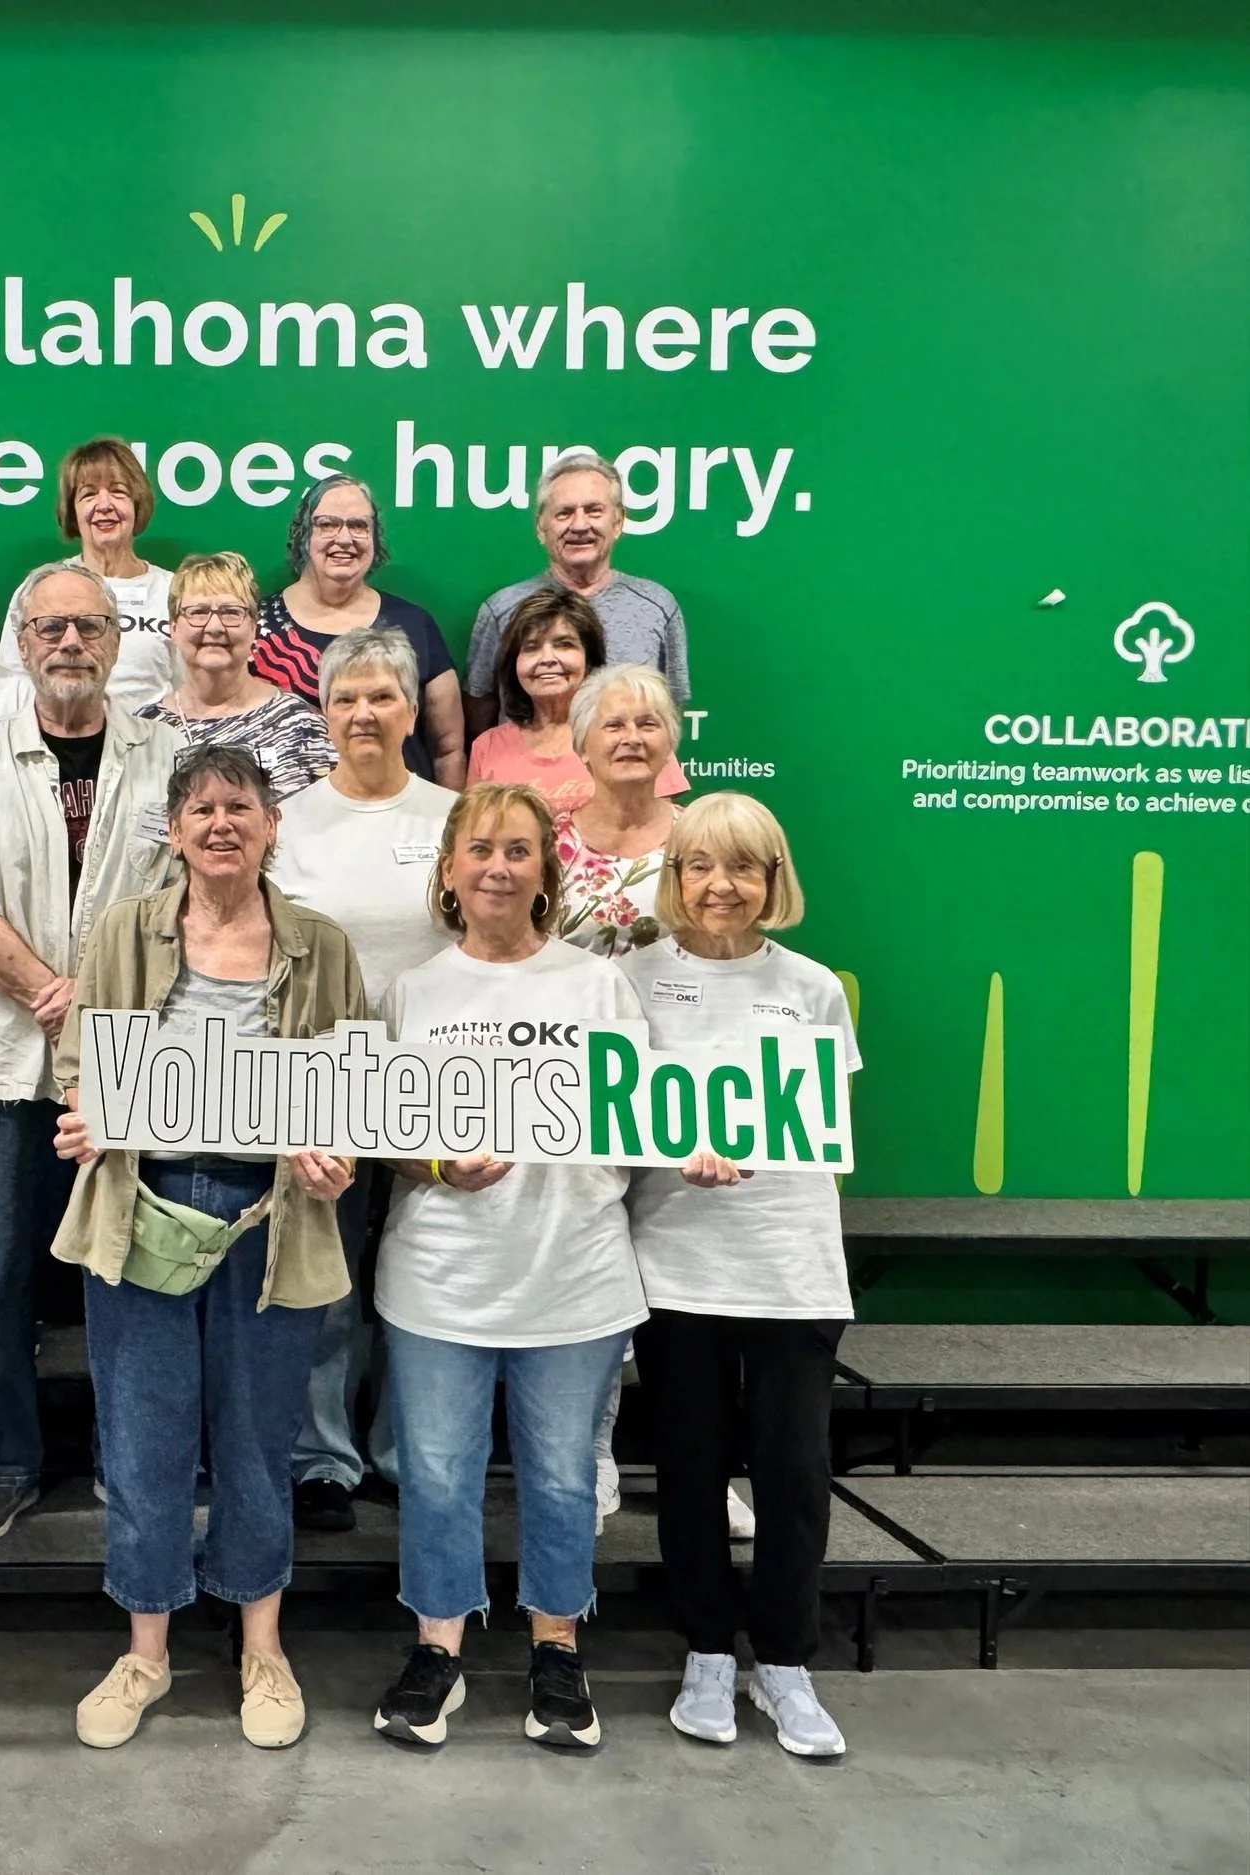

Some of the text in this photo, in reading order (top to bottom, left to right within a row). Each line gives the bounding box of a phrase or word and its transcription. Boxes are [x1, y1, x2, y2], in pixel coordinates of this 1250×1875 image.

[461, 282, 816, 373] where
[131, 441, 353, 507] oes
[395, 420, 811, 537] hugry.
[118, 614, 172, 639] OKC
[681, 757, 776, 778] rtunities
[902, 759, 1026, 786] Prioritizing
[1032, 761, 1150, 783] teamwork
[1155, 767, 1182, 784] as
[1188, 767, 1222, 785] we
[913, 789, 957, 809] and
[963, 790, 1109, 814] compromise
[1116, 793, 1140, 811] to
[1146, 792, 1237, 813] achieve
[430, 1022, 503, 1038] HEALTHY
[508, 1021, 580, 1048] OKC
[92, 1014, 842, 1162] VolunteersRock!
